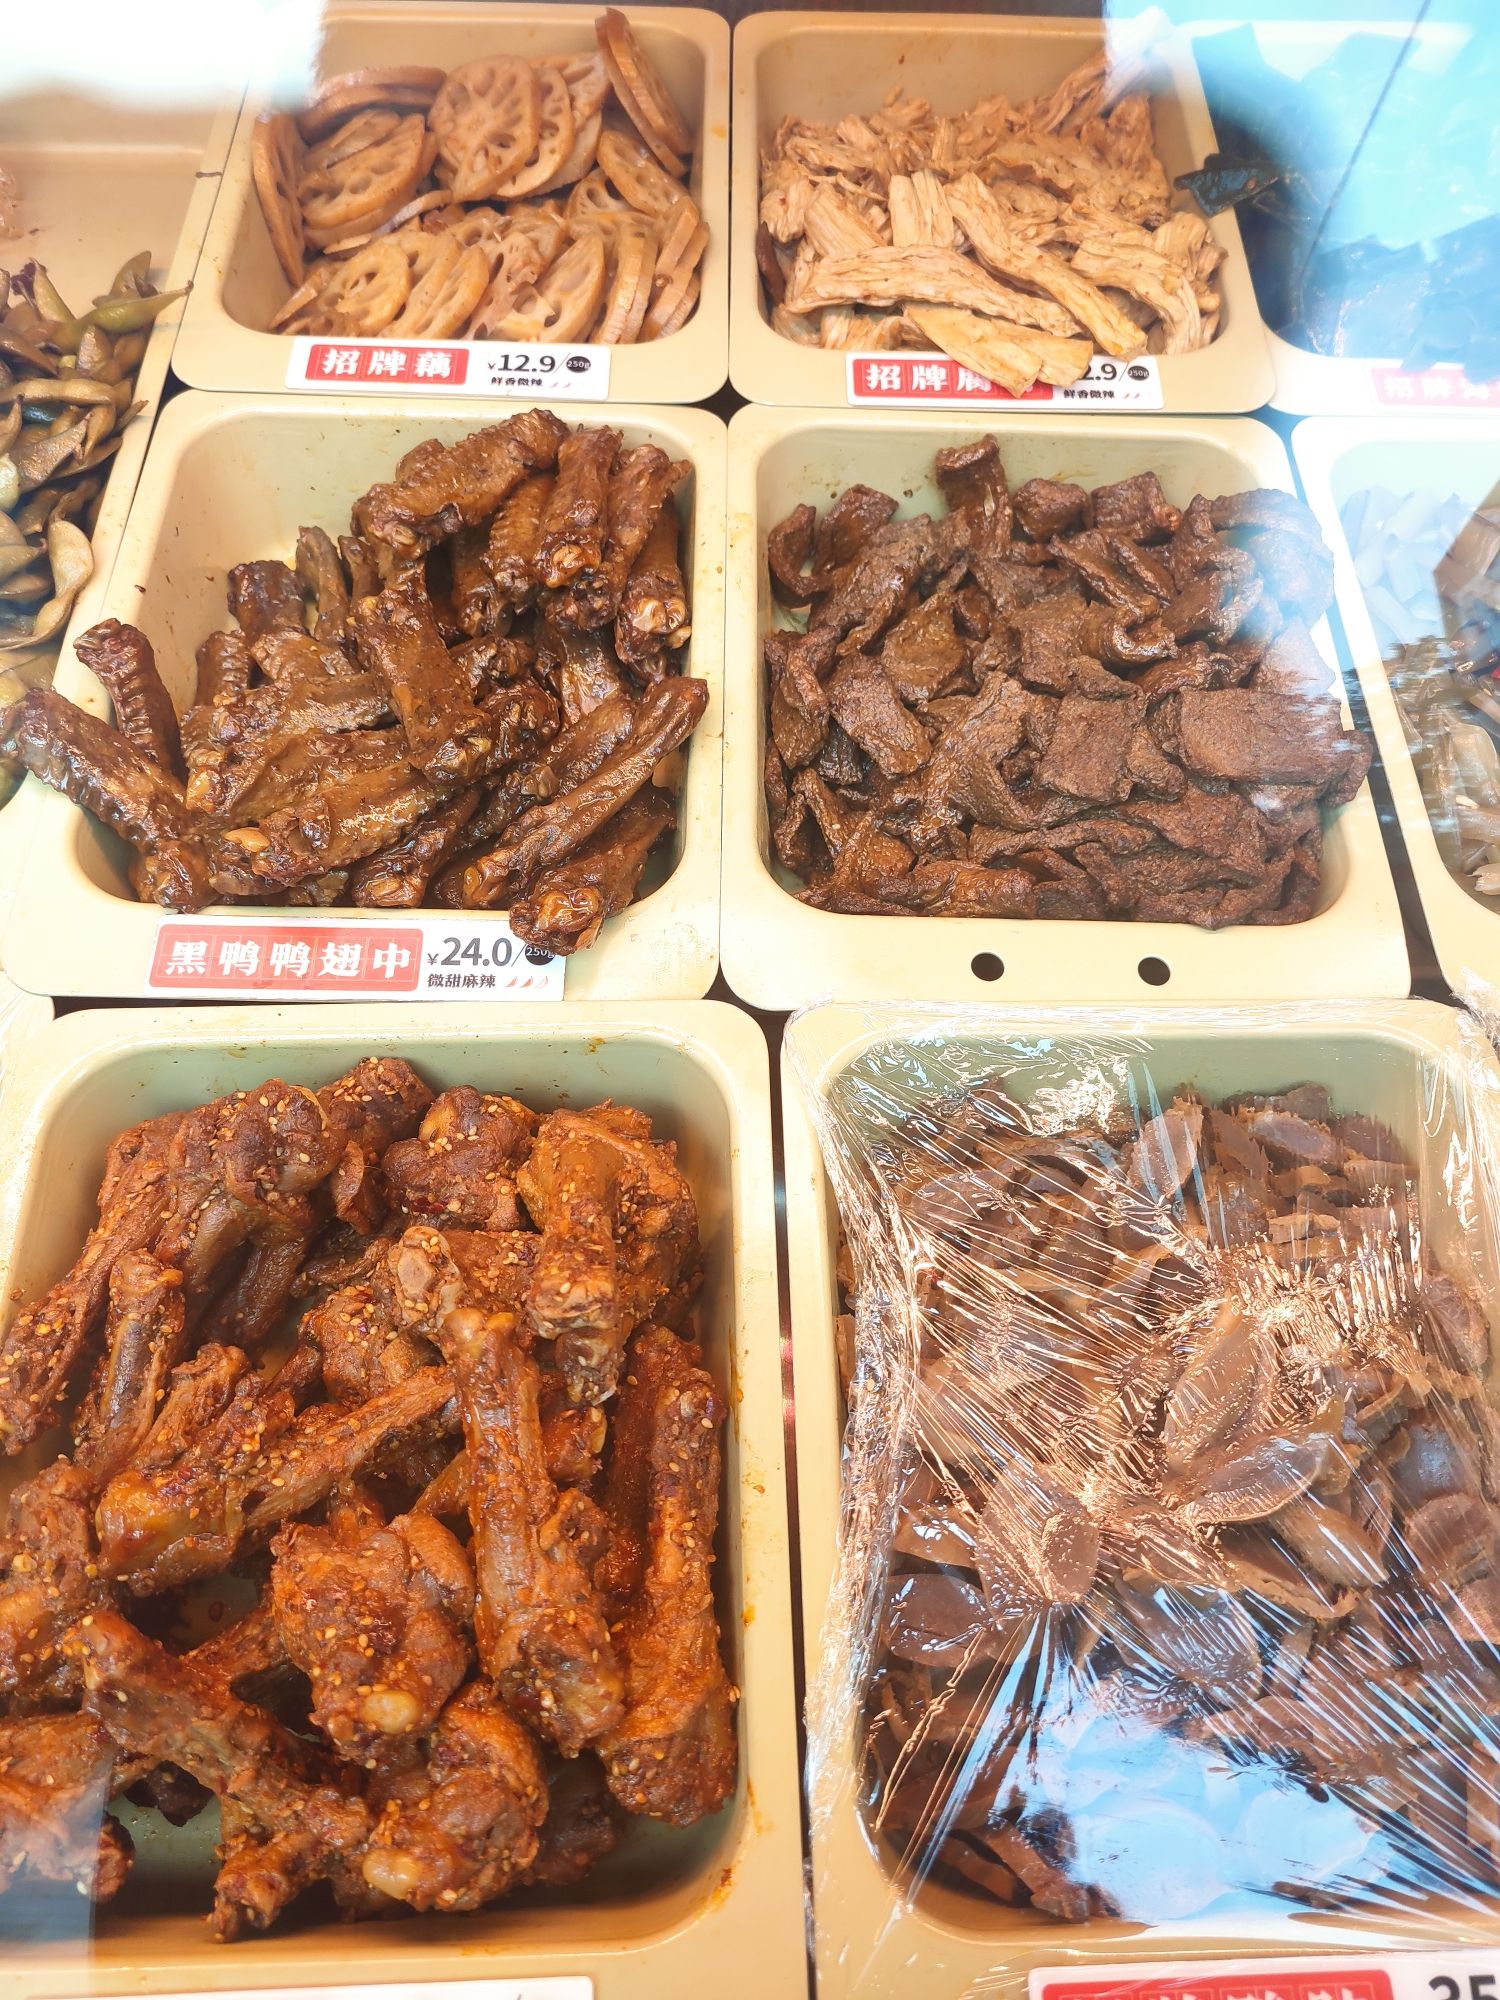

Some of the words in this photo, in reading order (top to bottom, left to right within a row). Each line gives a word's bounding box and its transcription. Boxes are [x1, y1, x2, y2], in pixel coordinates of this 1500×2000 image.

[322, 348, 451, 379] 招牌藕
[165, 941, 411, 979] 黑鸭鸭翅中
[427, 973, 497, 989] 微甜麻辣
